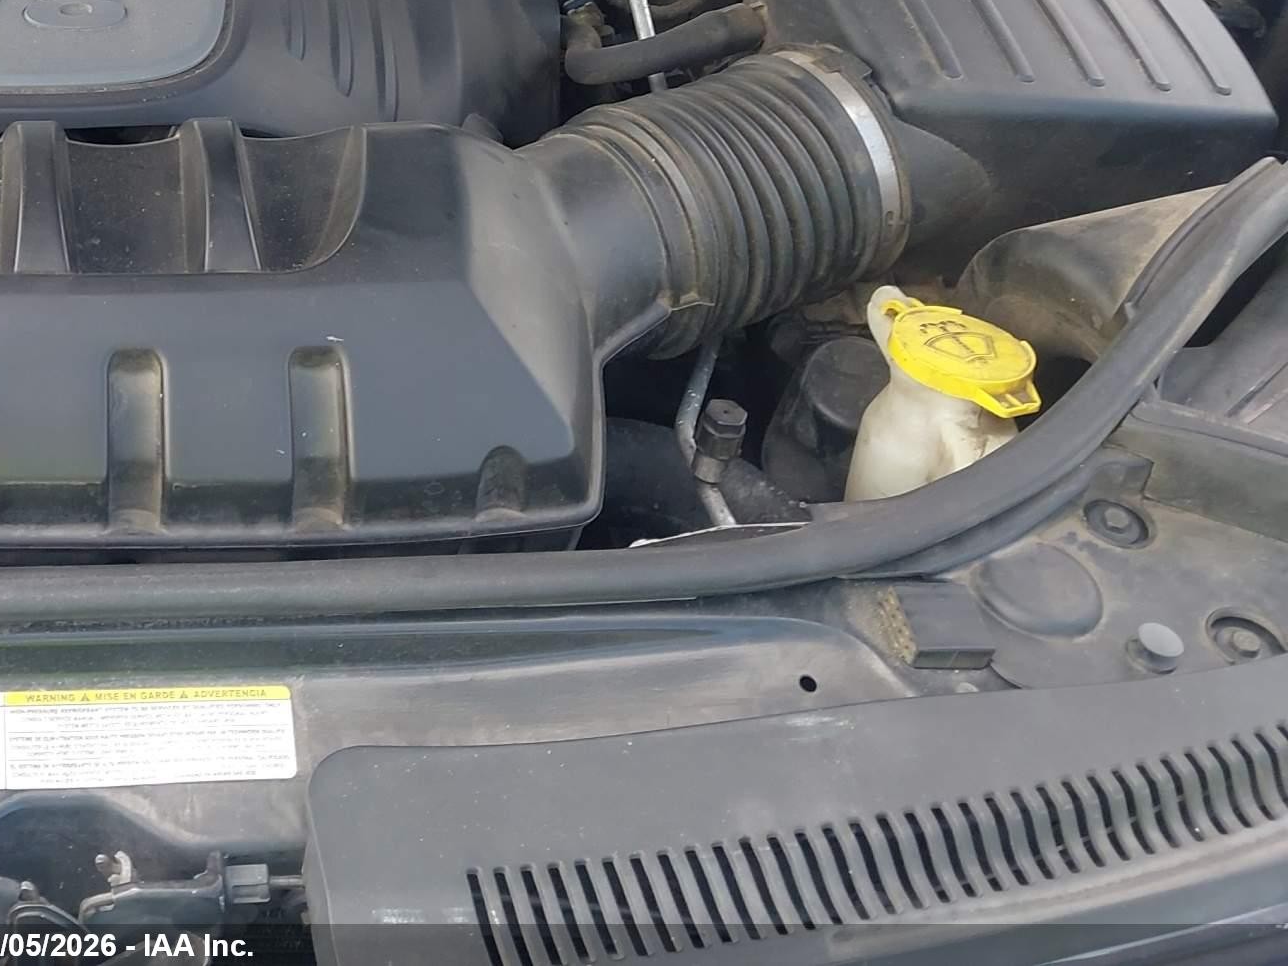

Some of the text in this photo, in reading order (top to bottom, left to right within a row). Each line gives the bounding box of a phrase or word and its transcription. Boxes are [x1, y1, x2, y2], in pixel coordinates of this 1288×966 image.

[25, 689, 267, 702] WARNING MISE EN GARDE ADVERTENCIA
